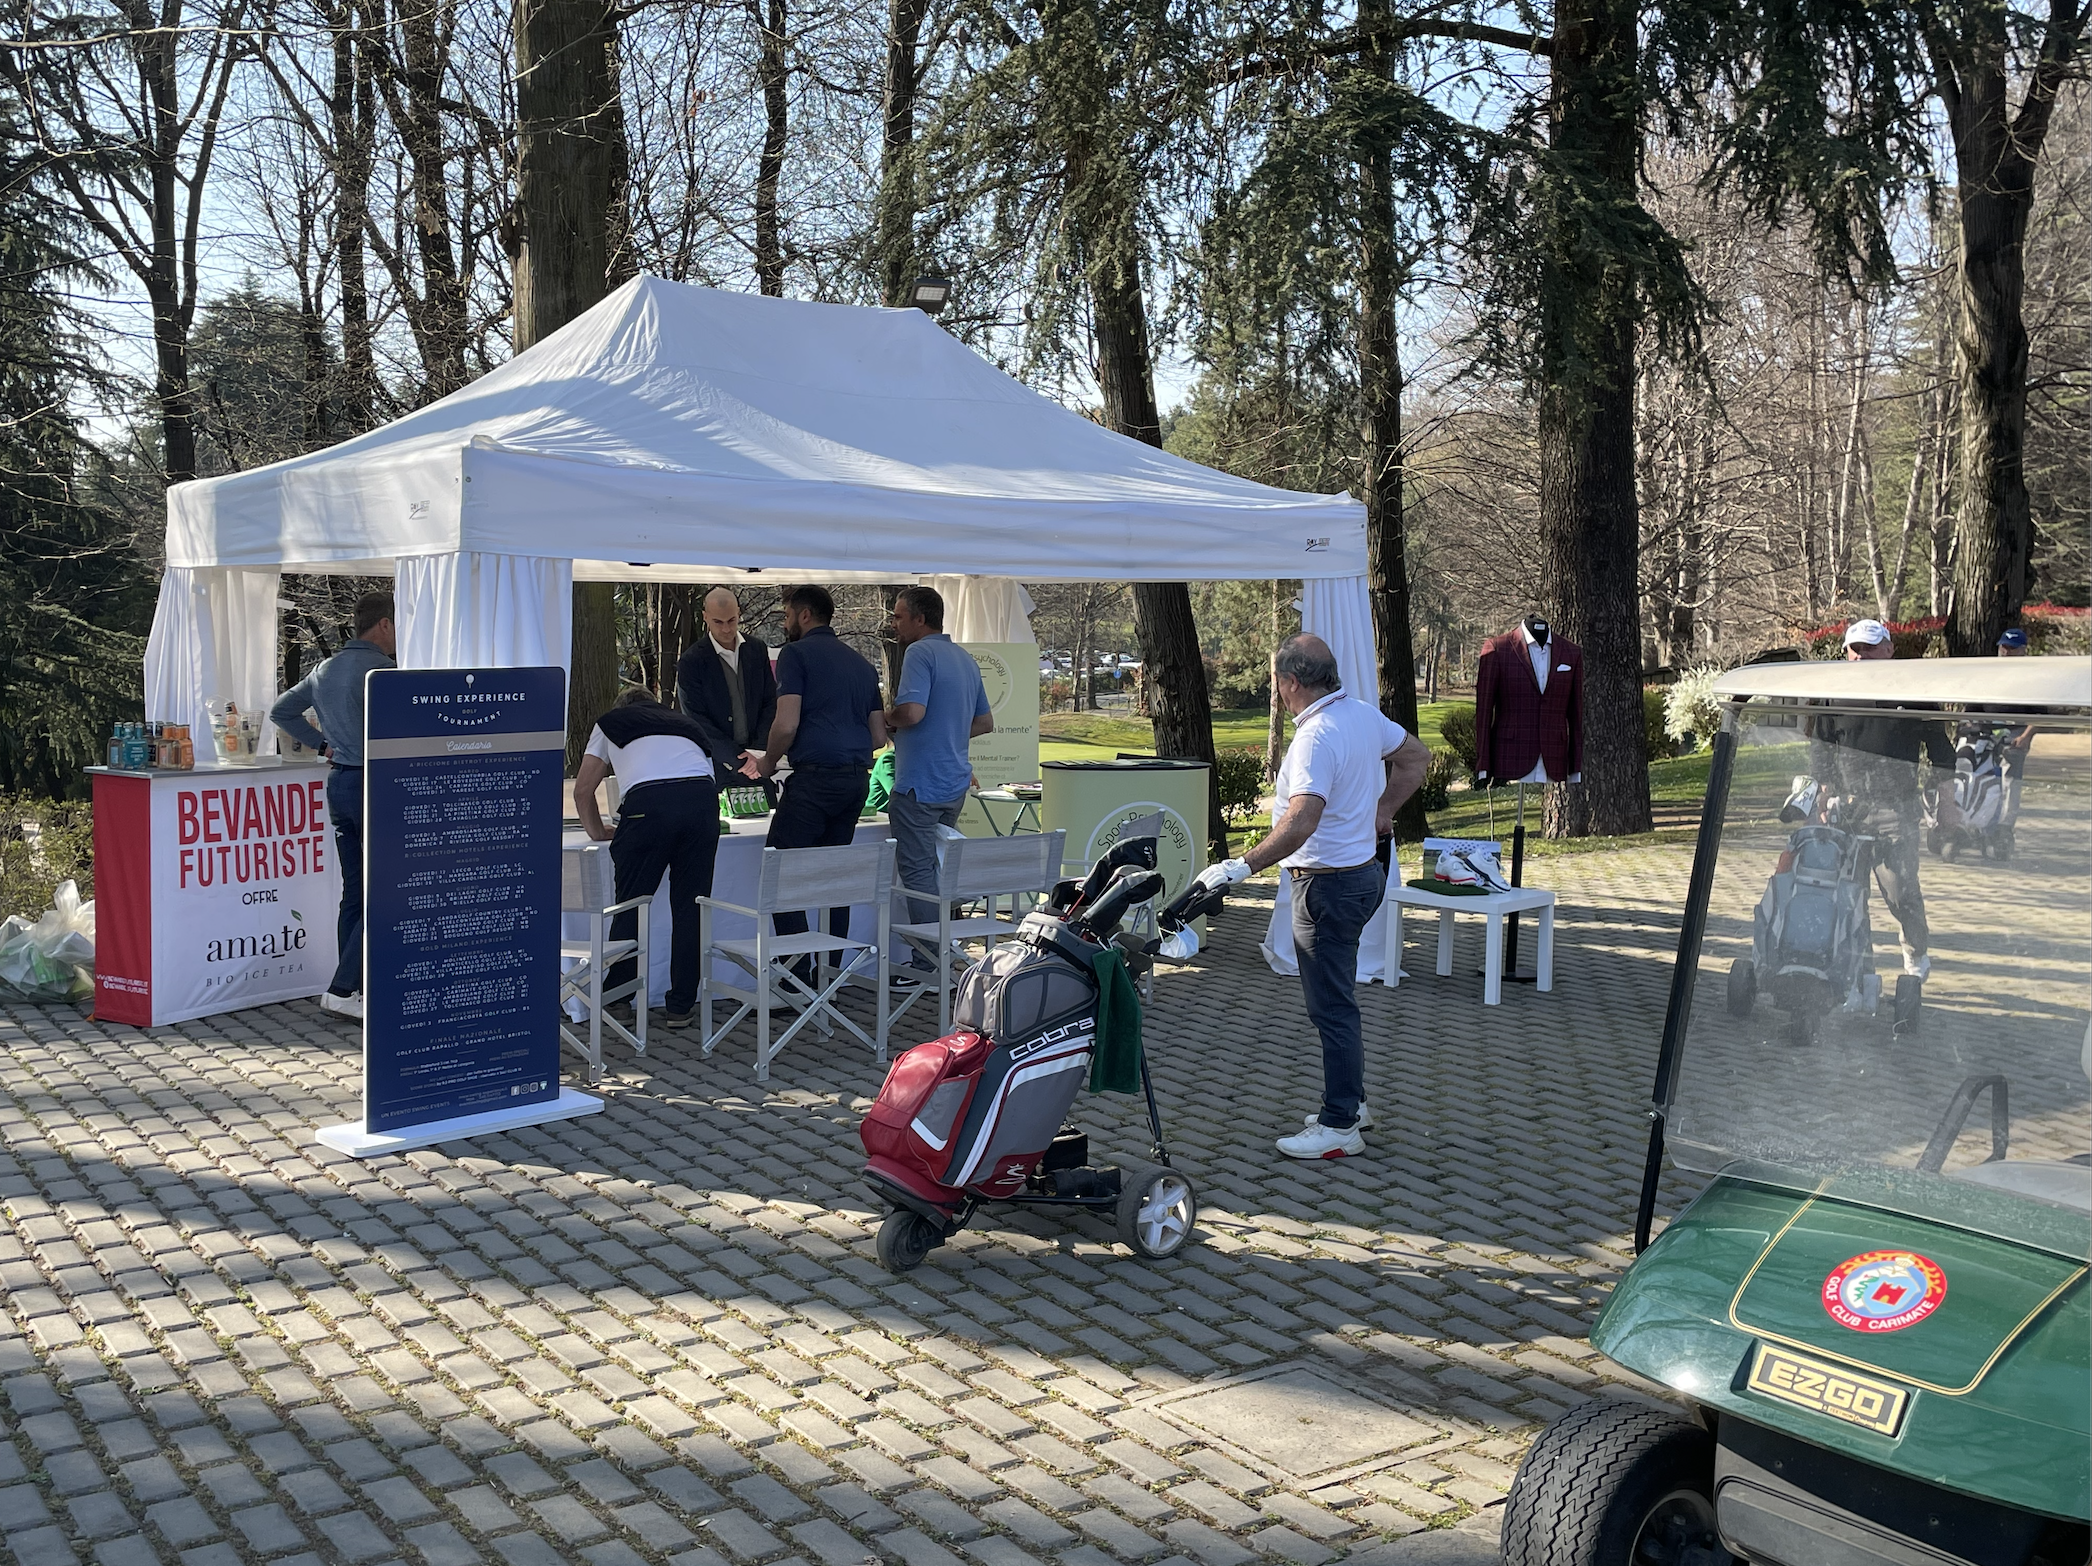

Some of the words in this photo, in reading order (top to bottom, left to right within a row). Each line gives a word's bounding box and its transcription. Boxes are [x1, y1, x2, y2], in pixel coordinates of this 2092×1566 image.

[412, 695, 450, 704] SWING
[456, 692, 526, 704] EXPERIENCE
[438, 710, 502, 726] TOURNAMENT
[446, 740, 492, 752] Calendario
[177, 781, 324, 845] BEVANDE
[179, 836, 324, 889] FUTURISTE
[242, 889, 278, 906] OFFRE
[206, 975, 234, 988] BIO
[244, 969, 270, 981] ICE
[278, 964, 303, 975] TEA
[430, 1035, 457, 1044] FINALE
[460, 1028, 502, 1039] NAZIONALE
[1009, 1016, 1095, 1061] cobra
[1826, 1276, 1841, 1302] GOLF
[1831, 1304, 1862, 1327] CLUB
[1868, 1300, 1935, 1330] CARIMATE
